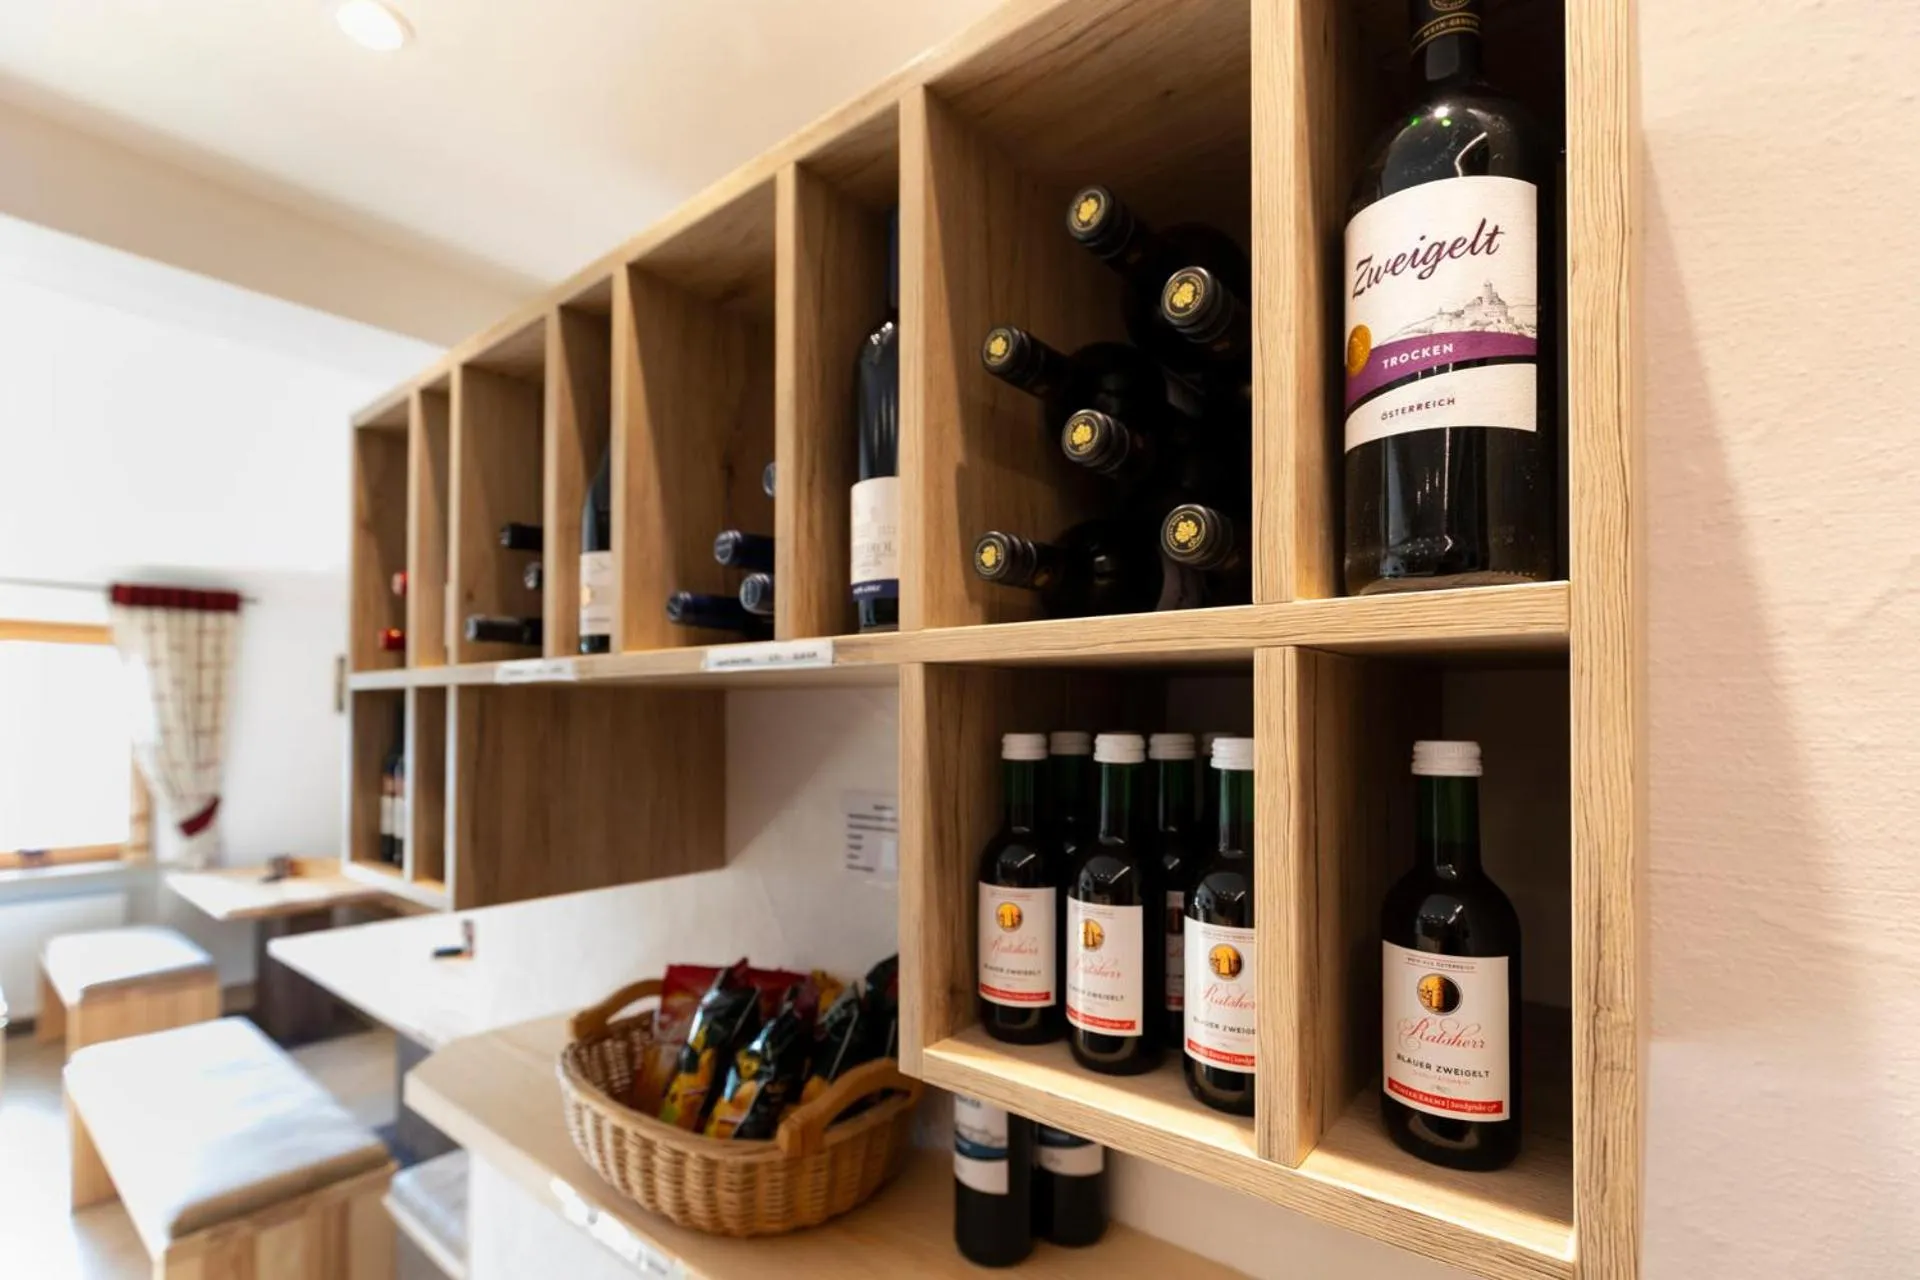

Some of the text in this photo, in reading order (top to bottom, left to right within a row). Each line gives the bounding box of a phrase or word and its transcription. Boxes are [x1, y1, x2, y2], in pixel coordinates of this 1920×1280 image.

[1352, 217, 1505, 299] Zweigelt
[1381, 342, 1454, 370] TROCKEN
[1380, 397, 1456, 421] ÖSTERREICH
[1204, 984, 1255, 1010] Ratsher
[1396, 1053, 1490, 1079] BLAUER ZWEIGELT
